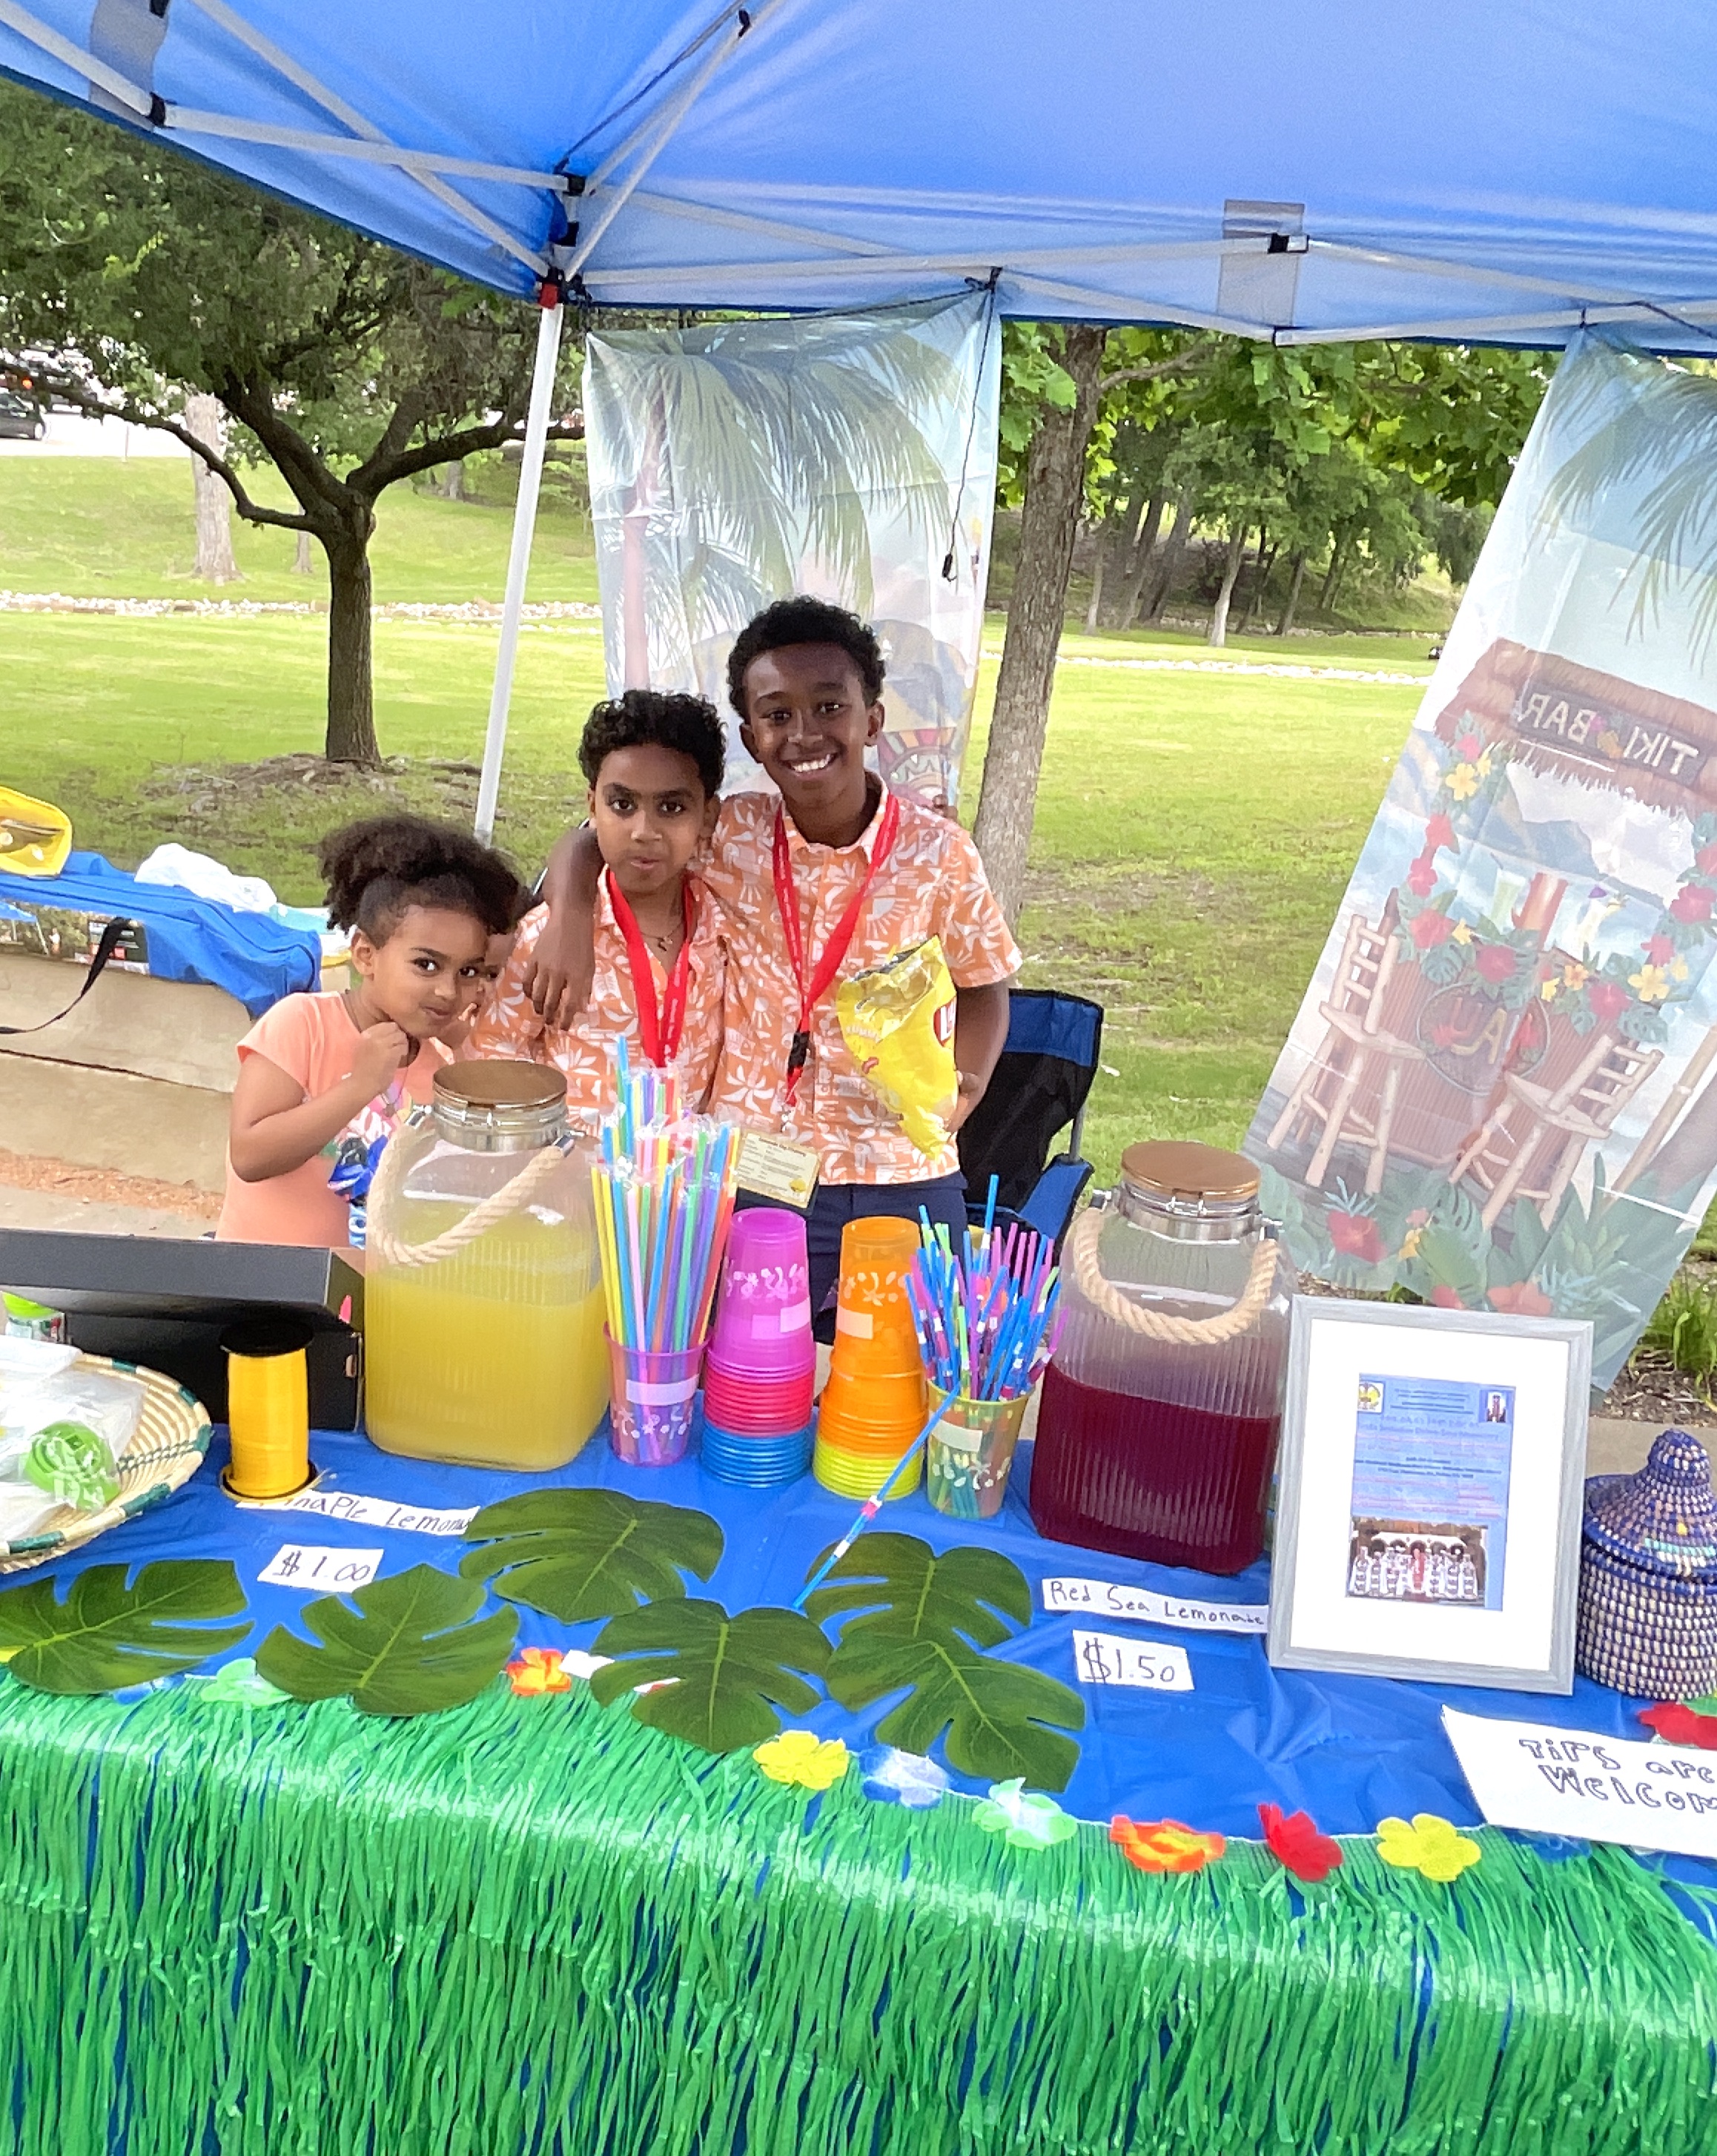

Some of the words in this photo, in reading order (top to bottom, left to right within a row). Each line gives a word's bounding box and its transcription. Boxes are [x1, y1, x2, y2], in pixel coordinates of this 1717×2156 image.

[273, 1550, 371, 1582] $1.00
[1051, 1581, 1091, 1604] Red
[1107, 1586, 1150, 1610] Sea
[1083, 1637, 1175, 1683] $1.50
